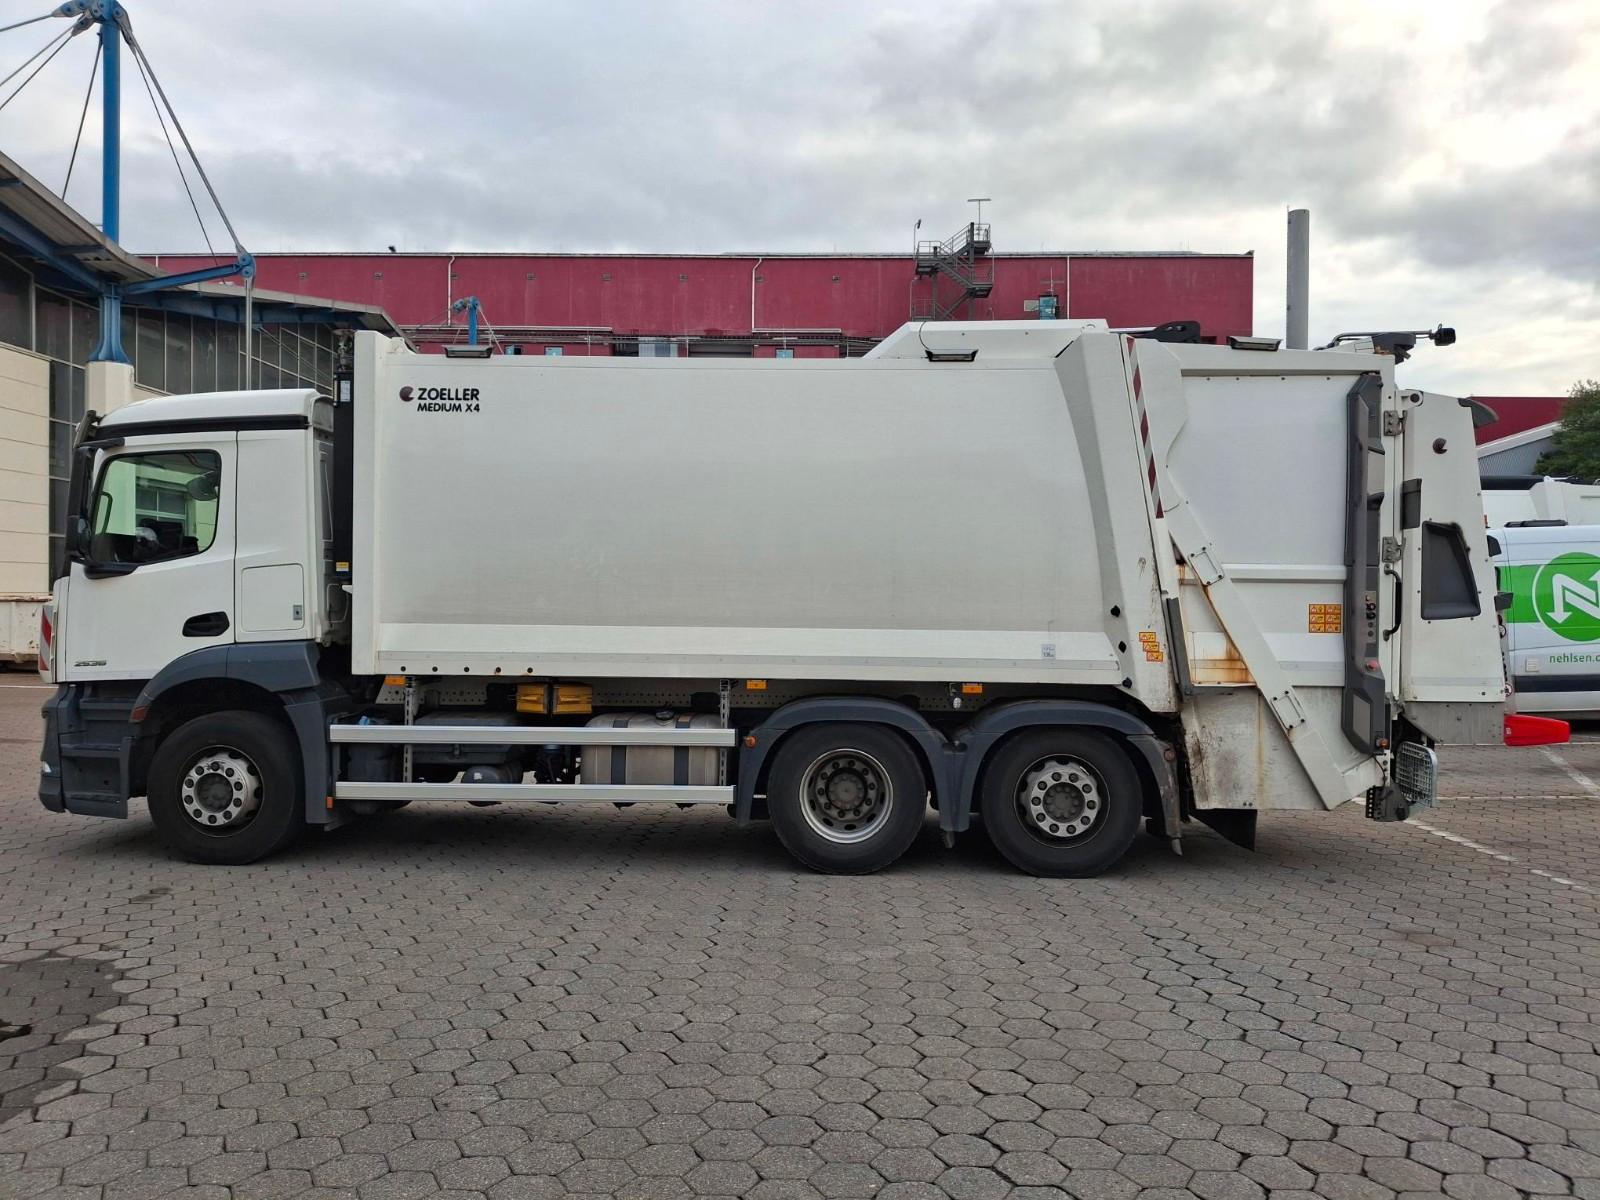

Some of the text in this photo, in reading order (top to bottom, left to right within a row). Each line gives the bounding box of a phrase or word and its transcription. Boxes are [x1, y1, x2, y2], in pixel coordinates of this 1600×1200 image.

[417, 387, 480, 401] ZOELLER
[416, 402, 480, 412] MEDIUM X4
